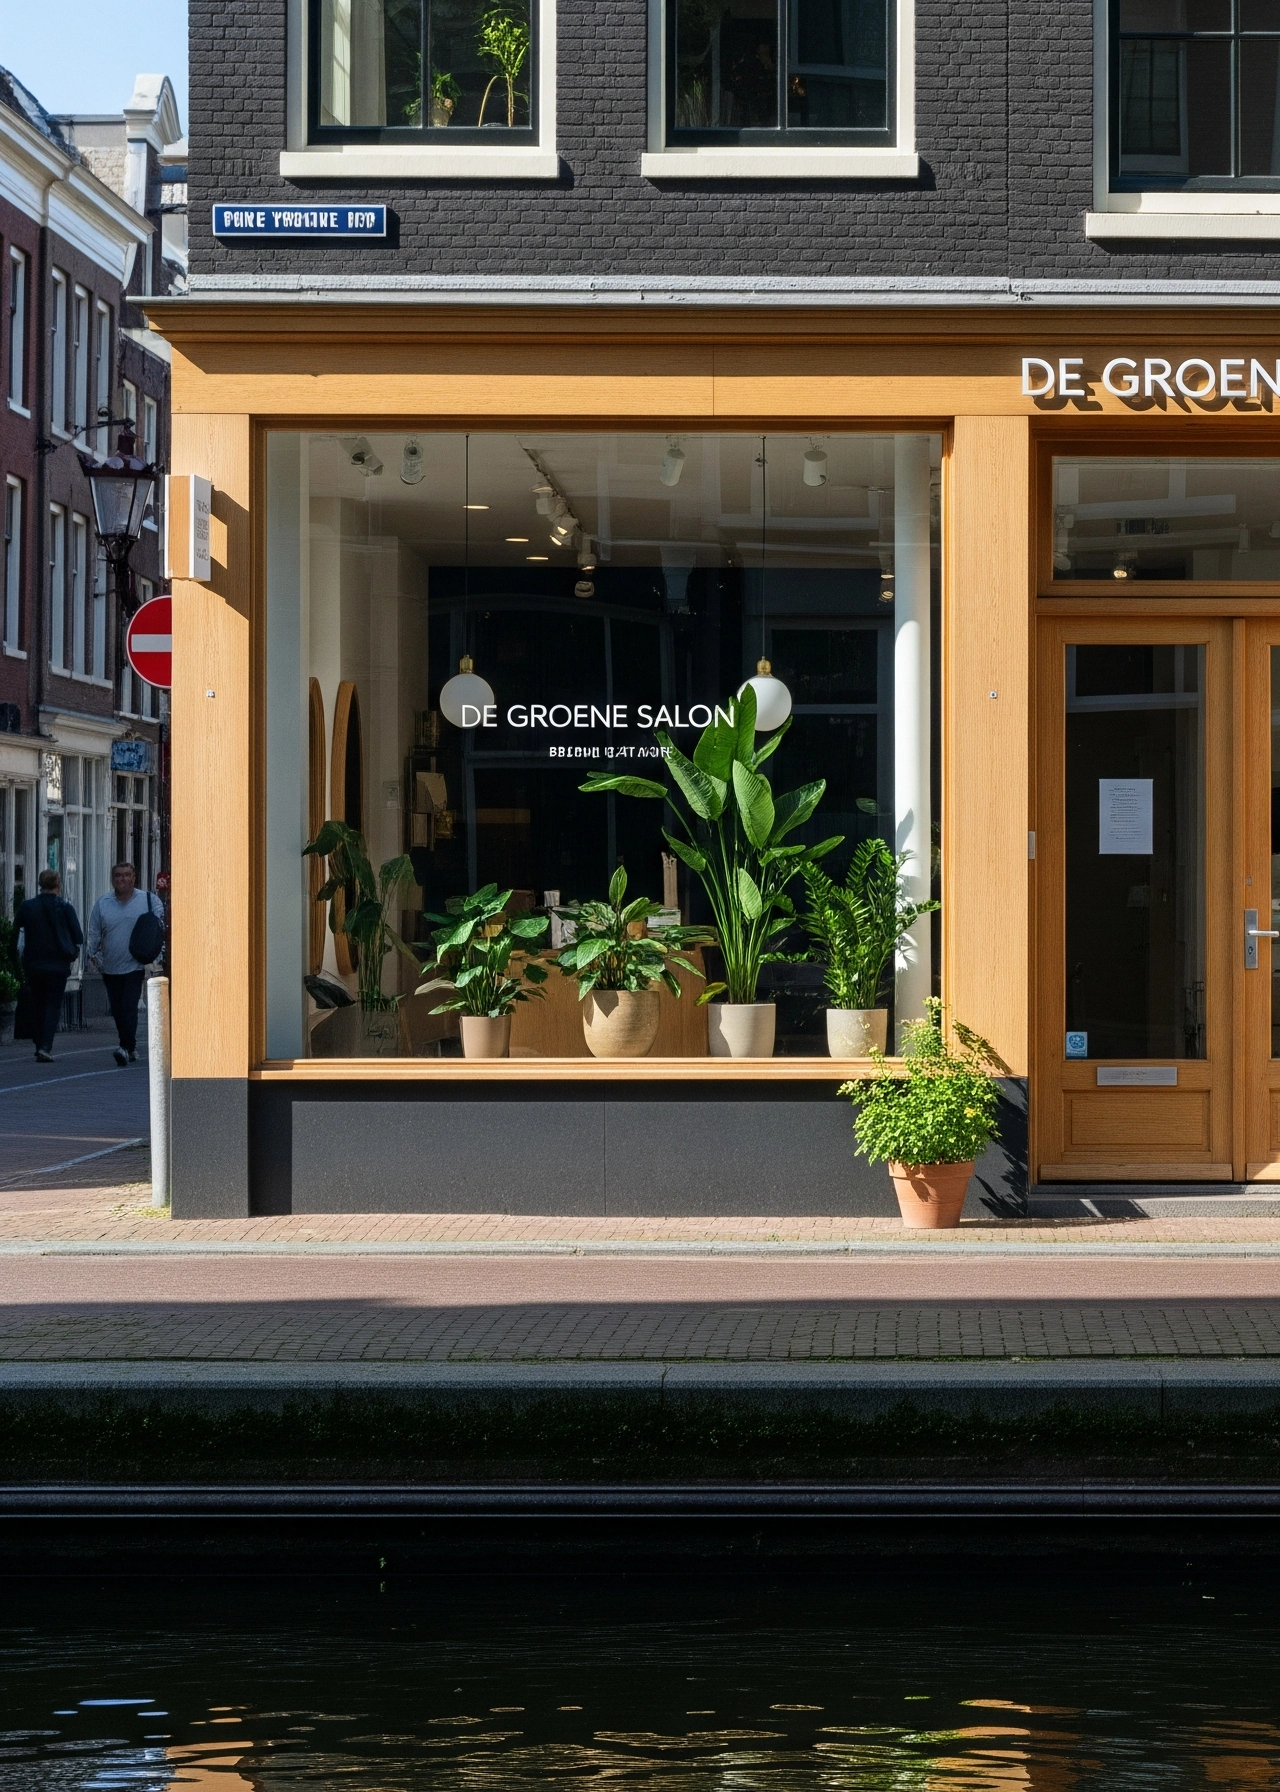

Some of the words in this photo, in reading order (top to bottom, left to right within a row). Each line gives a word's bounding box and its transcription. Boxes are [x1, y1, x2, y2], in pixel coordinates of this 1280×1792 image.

[1021, 358, 1085, 397] DE
[461, 704, 498, 728] DE
[507, 704, 629, 728] GROENE
[636, 704, 735, 728] SALON
